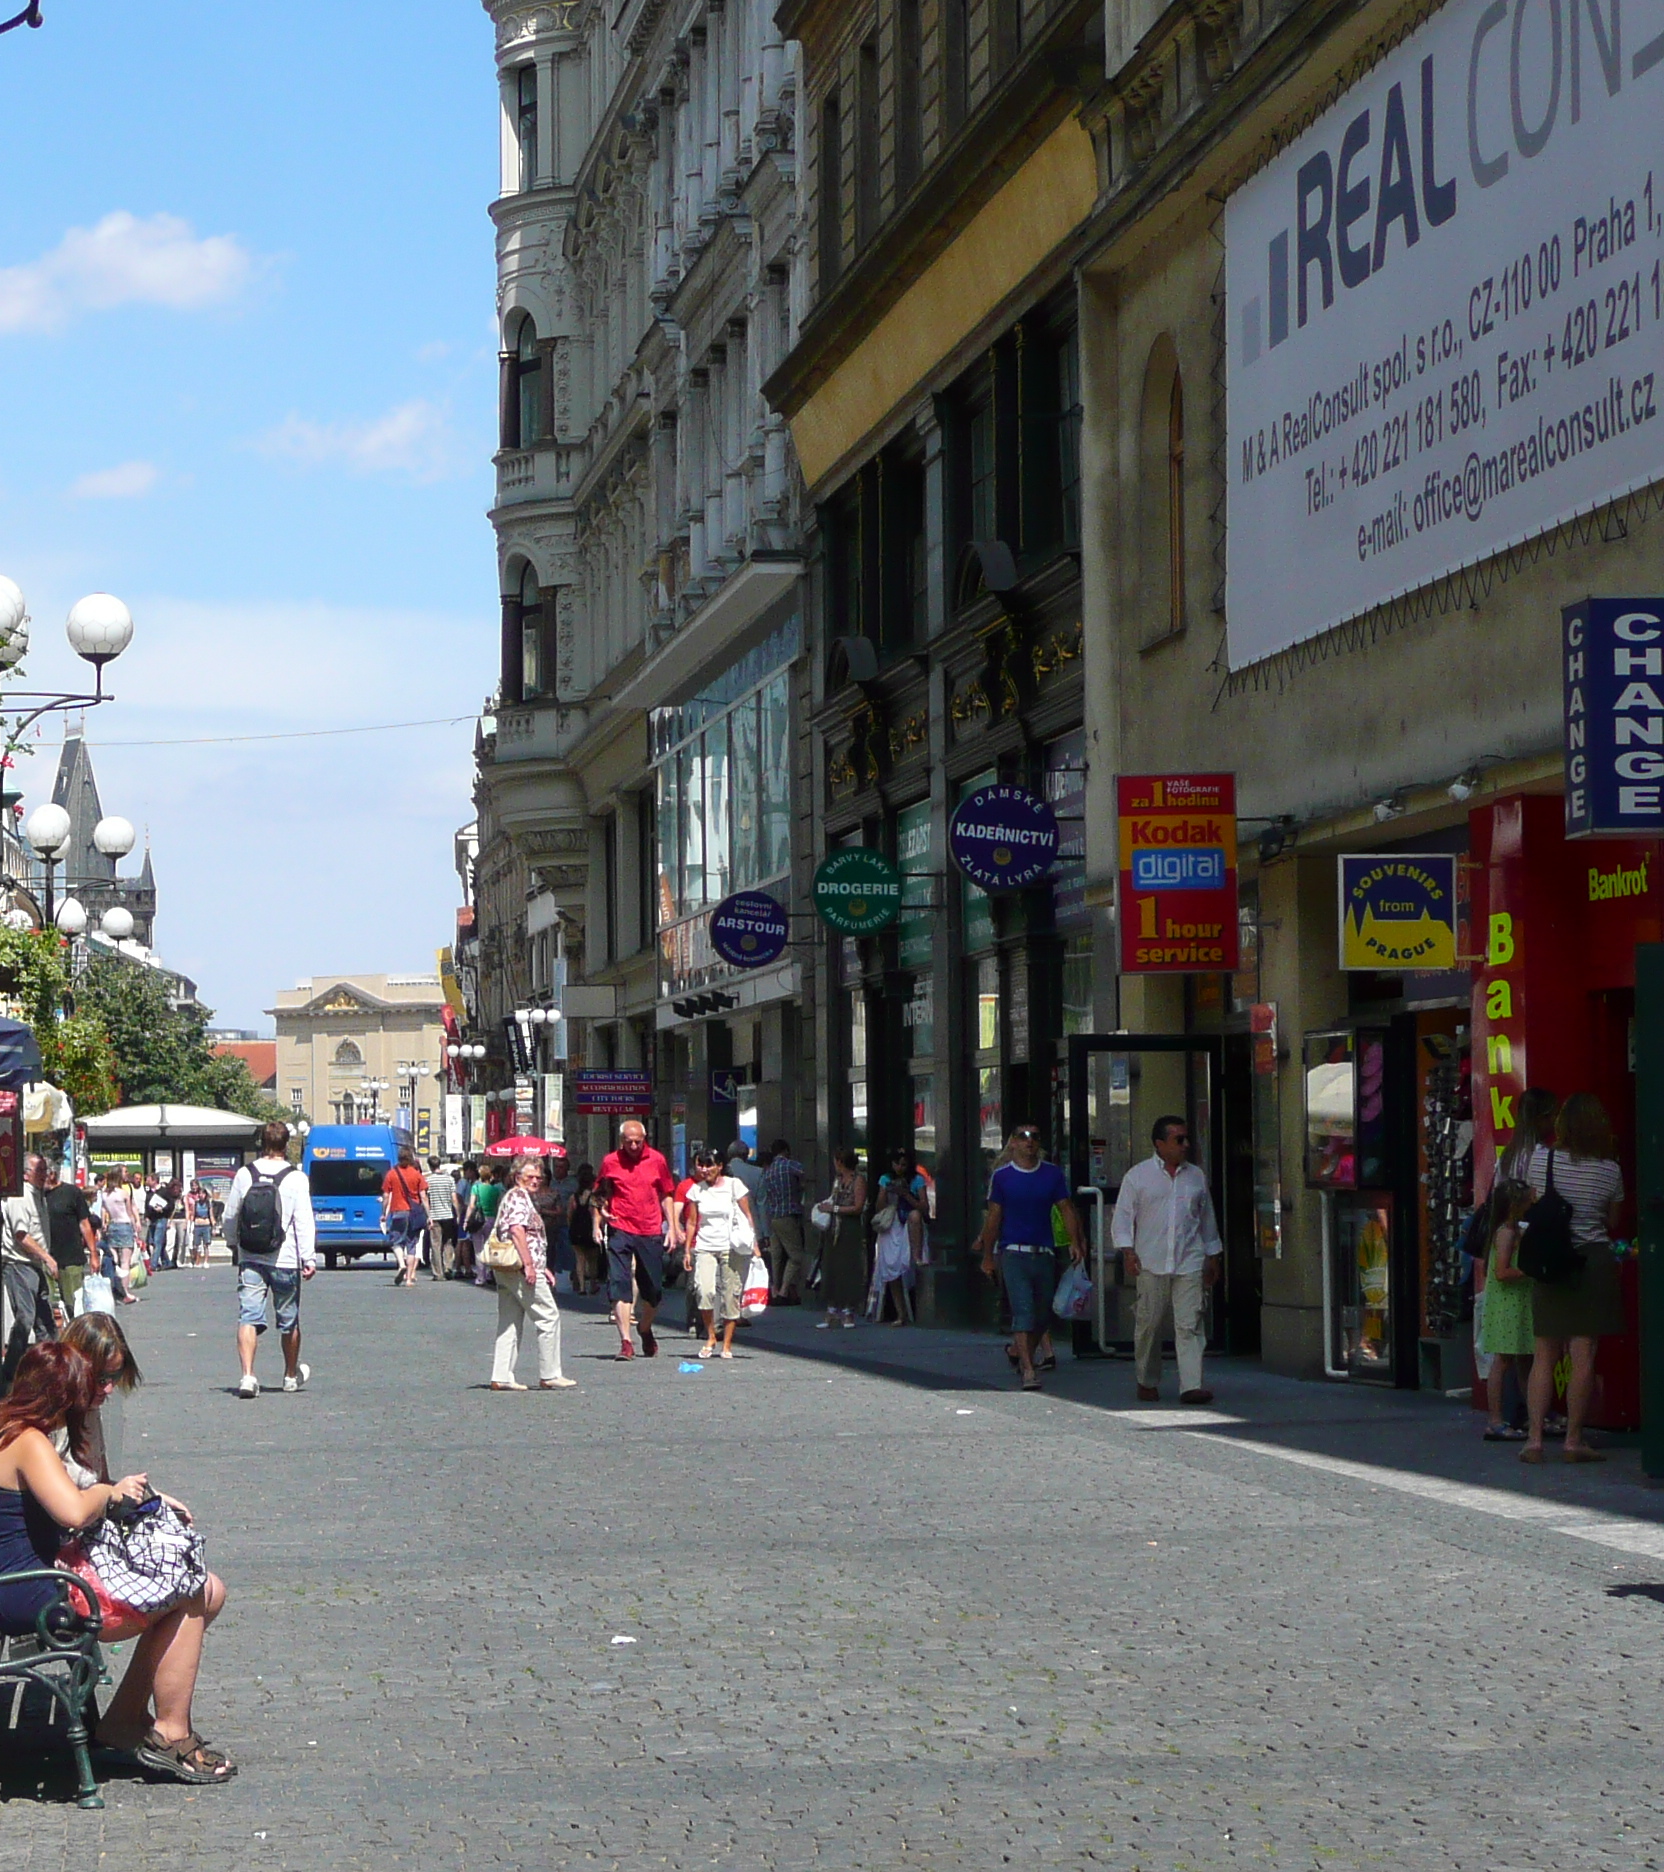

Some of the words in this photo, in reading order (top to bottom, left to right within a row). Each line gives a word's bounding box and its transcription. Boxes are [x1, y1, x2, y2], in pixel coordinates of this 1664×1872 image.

[1243, 434, 1253, 484] M
[1257, 428, 1266, 476] &
[1270, 429, 1279, 469] A
[1283, 362, 1369, 461] RealConsult
[1373, 333, 1411, 409] spol.
[1417, 335, 1426, 375] s
[1432, 318, 1462, 367] r.o.,
[1468, 253, 1532, 341] CZ-110
[1539, 233, 1561, 299] 00
[1573, 196, 1636, 278] Praha
[1305, 460, 1334, 516] Tel.:
[1352, 430, 1379, 488] 420
[1382, 411, 1409, 474] 221
[1416, 390, 1444, 453] 181
[1450, 369, 1487, 435] 580,
[1497, 348, 1537, 410] Fax:
[1561, 299, 1598, 370] 420
[1604, 271, 1641, 349] 221
[1357, 490, 1410, 562] e-mail:
[1413, 372, 1657, 523] office@marealconsult.cz
[1567, 617, 1587, 819] CHANGE
[1611, 612, 1664, 815] CHANGE
[1130, 796, 1150, 808] za
[1150, 780, 1165, 808] 1
[1166, 793, 1220, 808] hodinu
[955, 821, 1055, 848] KADEŘNICTVÍ
[1130, 819, 1224, 845] Kodak
[960, 853, 1001, 886] ZLATÁ
[1006, 862, 1044, 887] LYRA
[1137, 851, 1220, 884] digital
[1351, 863, 1443, 901] SOUVENIRS
[817, 881, 900, 897] DROGERIE
[824, 905, 892, 931] PARFUMERIE
[1136, 895, 1159, 940] 1
[1165, 917, 1223, 939] hour
[1378, 898, 1415, 914] from
[716, 916, 786, 936] ARSTOUR
[1135, 942, 1224, 965] service
[1364, 936, 1436, 961] PRAGUE
